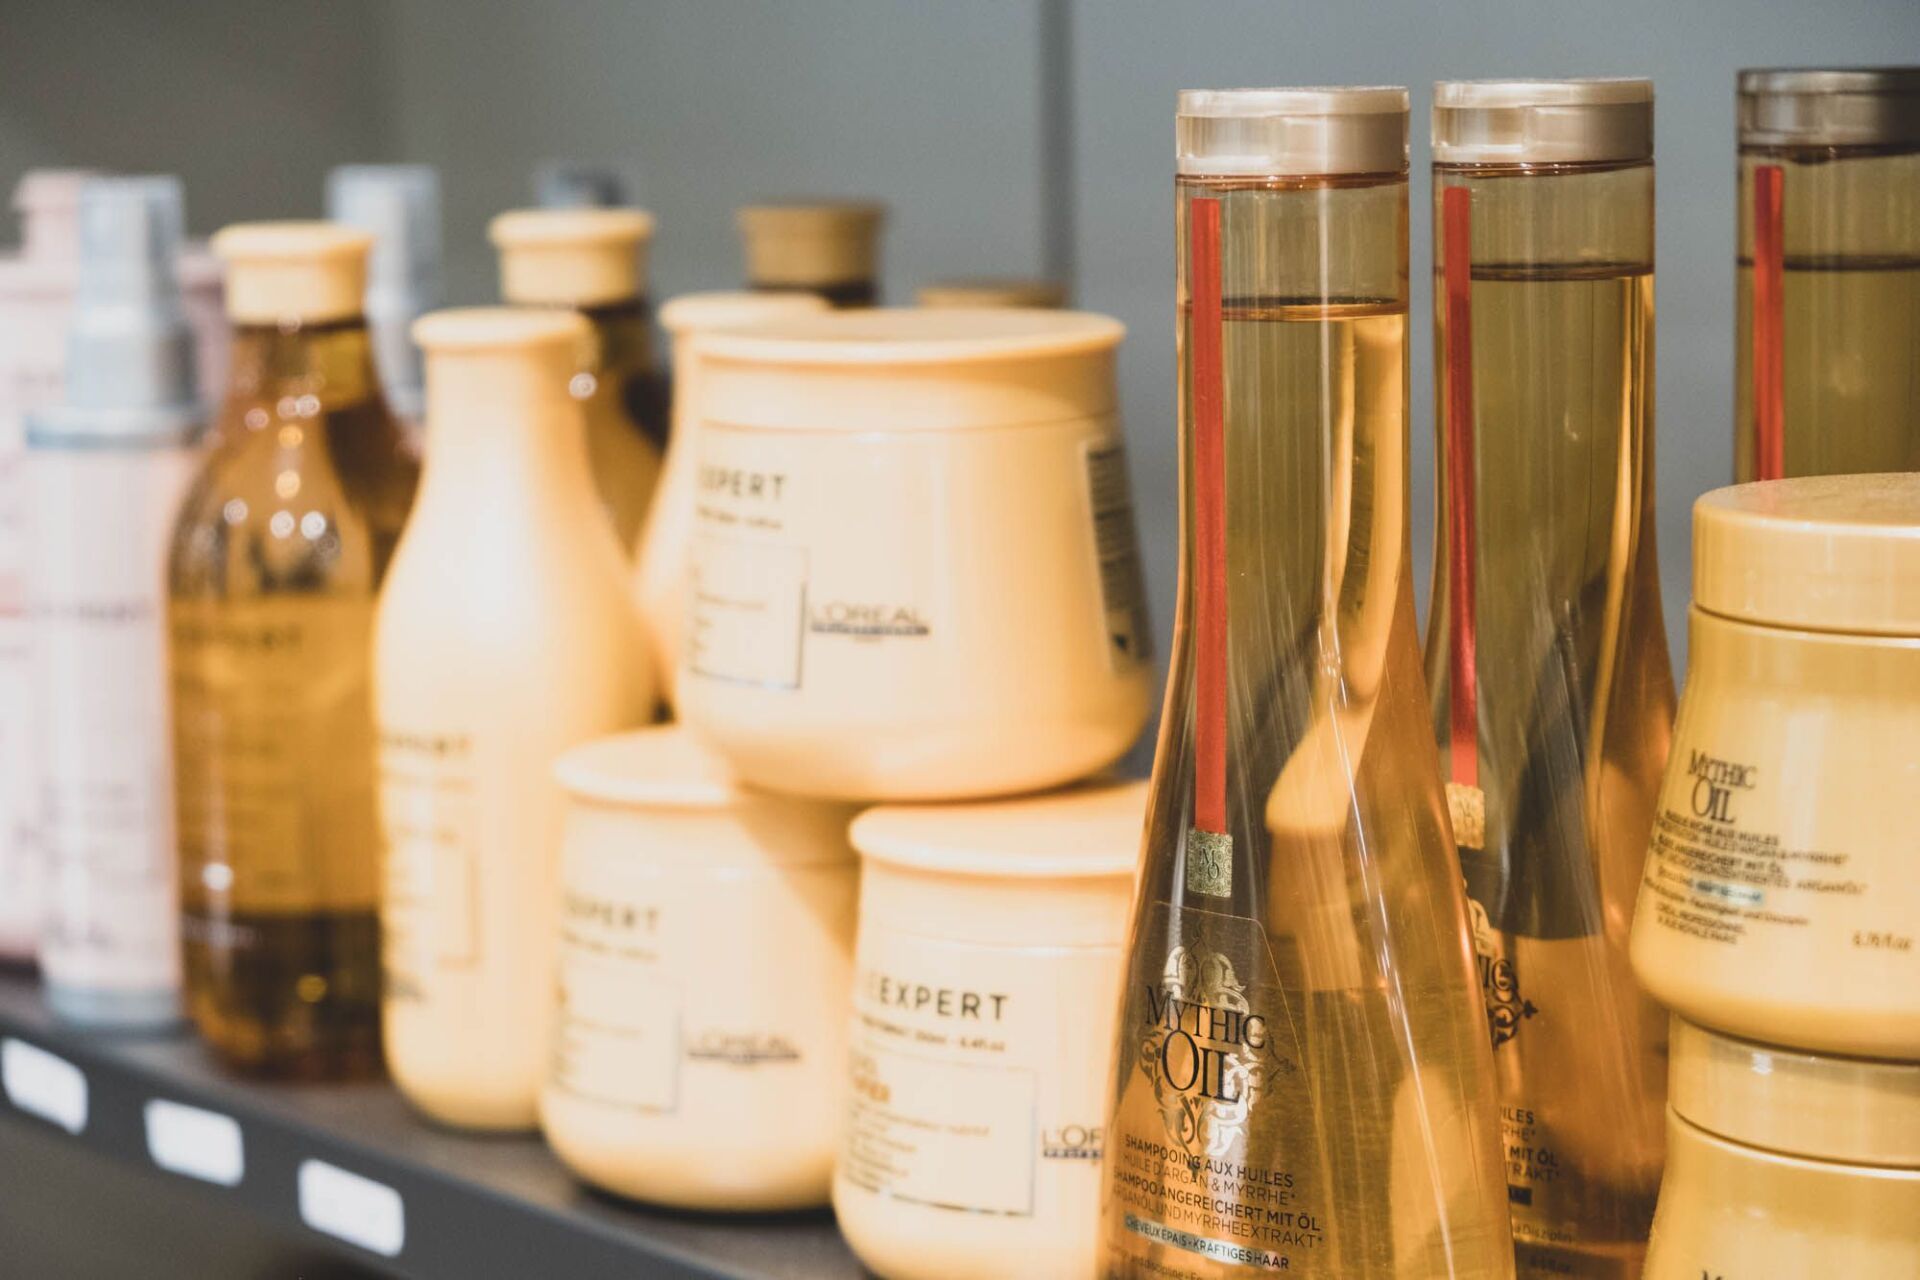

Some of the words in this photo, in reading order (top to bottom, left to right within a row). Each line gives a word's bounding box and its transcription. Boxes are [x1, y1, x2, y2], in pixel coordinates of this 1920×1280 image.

[1688, 748, 1757, 789] MYTHIC
[1692, 775, 1736, 823] OIL
[880, 976, 1009, 1021] EXPERT
[1145, 985, 1266, 1049] MYTHIC
[1161, 1029, 1241, 1104] OIL
[1124, 1133, 1201, 1170] SHAMPOOING
[1204, 1161, 1233, 1177] AUX
[1236, 1166, 1294, 1188] HUILES
[1124, 1152, 1152, 1175] HUILE
[1211, 1181, 1221, 1193] &
[1155, 1200, 1182, 1220] UND
[1159, 1188, 1263, 1222] ANGEREICHERT
[1266, 1212, 1294, 1227] MIT
[1298, 1215, 1321, 1232] ÖL
[1193, 1236, 1252, 1262] KRAFTIGES
[1254, 1251, 1289, 1270] HAAR
